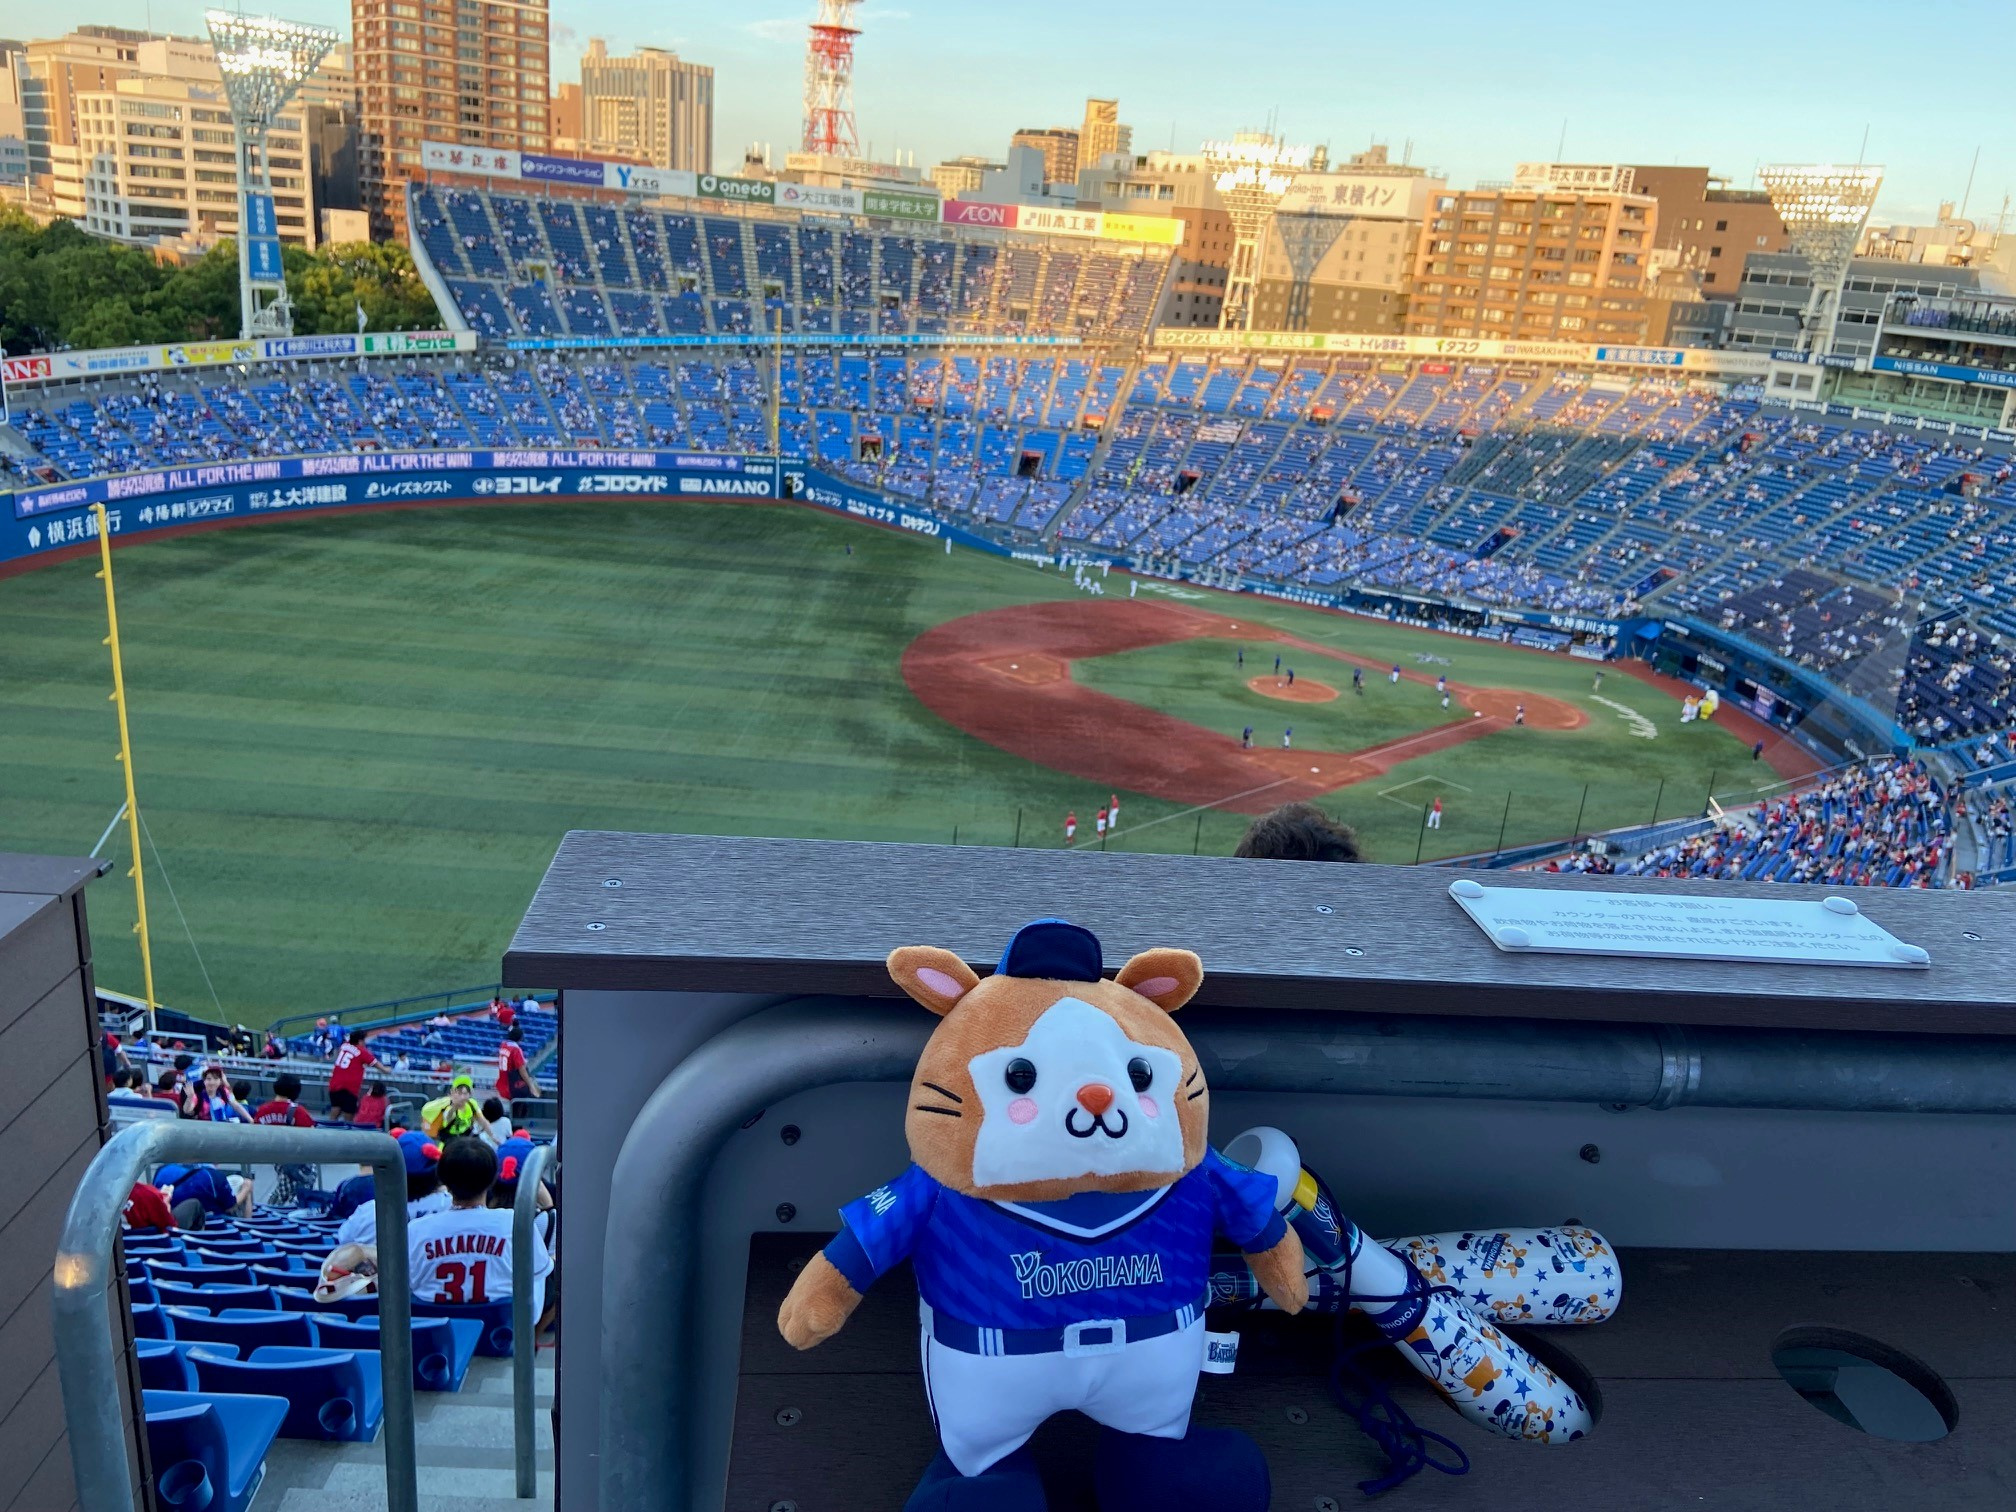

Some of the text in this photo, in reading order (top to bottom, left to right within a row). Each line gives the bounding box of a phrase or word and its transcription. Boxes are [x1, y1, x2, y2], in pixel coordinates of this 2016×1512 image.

[719, 180, 771, 197] onedo
[1333, 184, 1396, 207] 東横イン
[865, 197, 936, 216] 関東学院大学
[1037, 213, 1095, 231] 川本工業
[375, 335, 452, 351] 業務スーパー
[1446, 341, 1480, 353] タスク
[1894, 360, 1939, 375] NISSAN
[1977, 371, 2016, 385] NISSA
[364, 455, 391, 471] ALL
[391, 454, 420, 470] FOR
[420, 453, 445, 468] THE
[446, 452, 473, 468] WIN!
[552, 452, 578, 466] ALL
[578, 452, 606, 466] FOR
[606, 452, 630, 466] THE
[631, 453, 656, 467] WIN!
[169, 470, 196, 489] ALL
[197, 467, 225, 485] FOR
[225, 464, 251, 483] THE
[254, 461, 281, 480] WIN!
[495, 476, 562, 493] ヨコレイ
[594, 474, 668, 493] コロワイド
[286, 484, 347, 505] 大洋建設
[380, 480, 452, 496] レイズネクスト
[702, 478, 770, 495] AMANO
[139, 503, 186, 524] 崎陽軒
[901, 514, 941, 535] ロキテクノ
[1564, 616, 1619, 636] 神奈川大学
[425, 1234, 506, 1260] SAKAKURA
[434, 1260, 490, 1304] 31
[1010, 1248, 1163, 1299] YOKOHAMA
